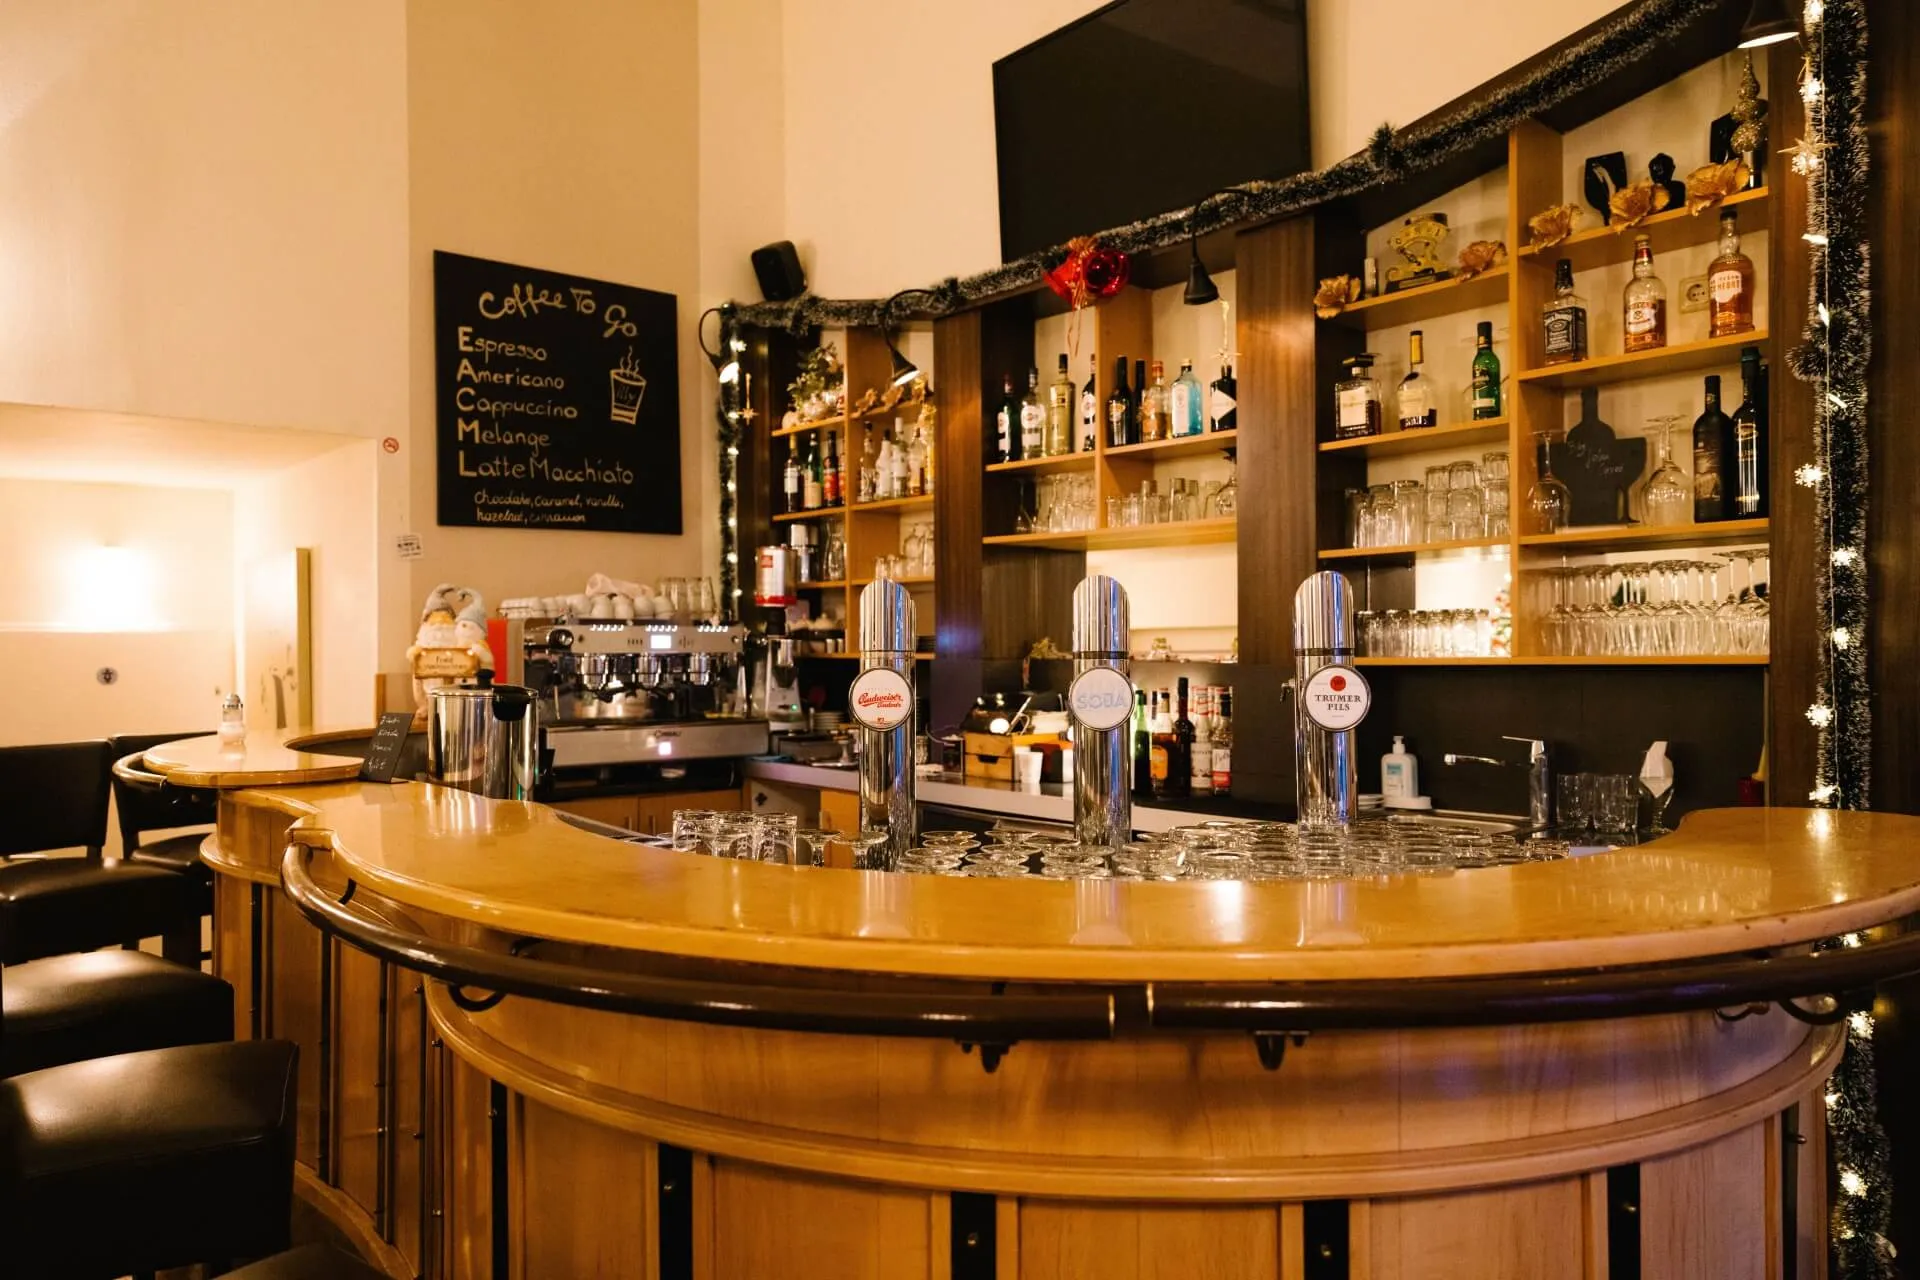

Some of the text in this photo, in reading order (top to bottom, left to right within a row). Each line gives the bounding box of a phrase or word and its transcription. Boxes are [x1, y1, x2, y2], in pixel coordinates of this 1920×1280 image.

[479, 283, 596, 319] Coffee To
[603, 305, 638, 338] Go
[458, 326, 547, 363] Espresso
[457, 358, 565, 390] Americano
[456, 387, 578, 418] Cappuccino
[457, 417, 551, 457] Melange
[459, 450, 634, 484] Latte Macchiato
[1314, 694, 1362, 703] TRUMER
[1328, 703, 1351, 711] PILS
